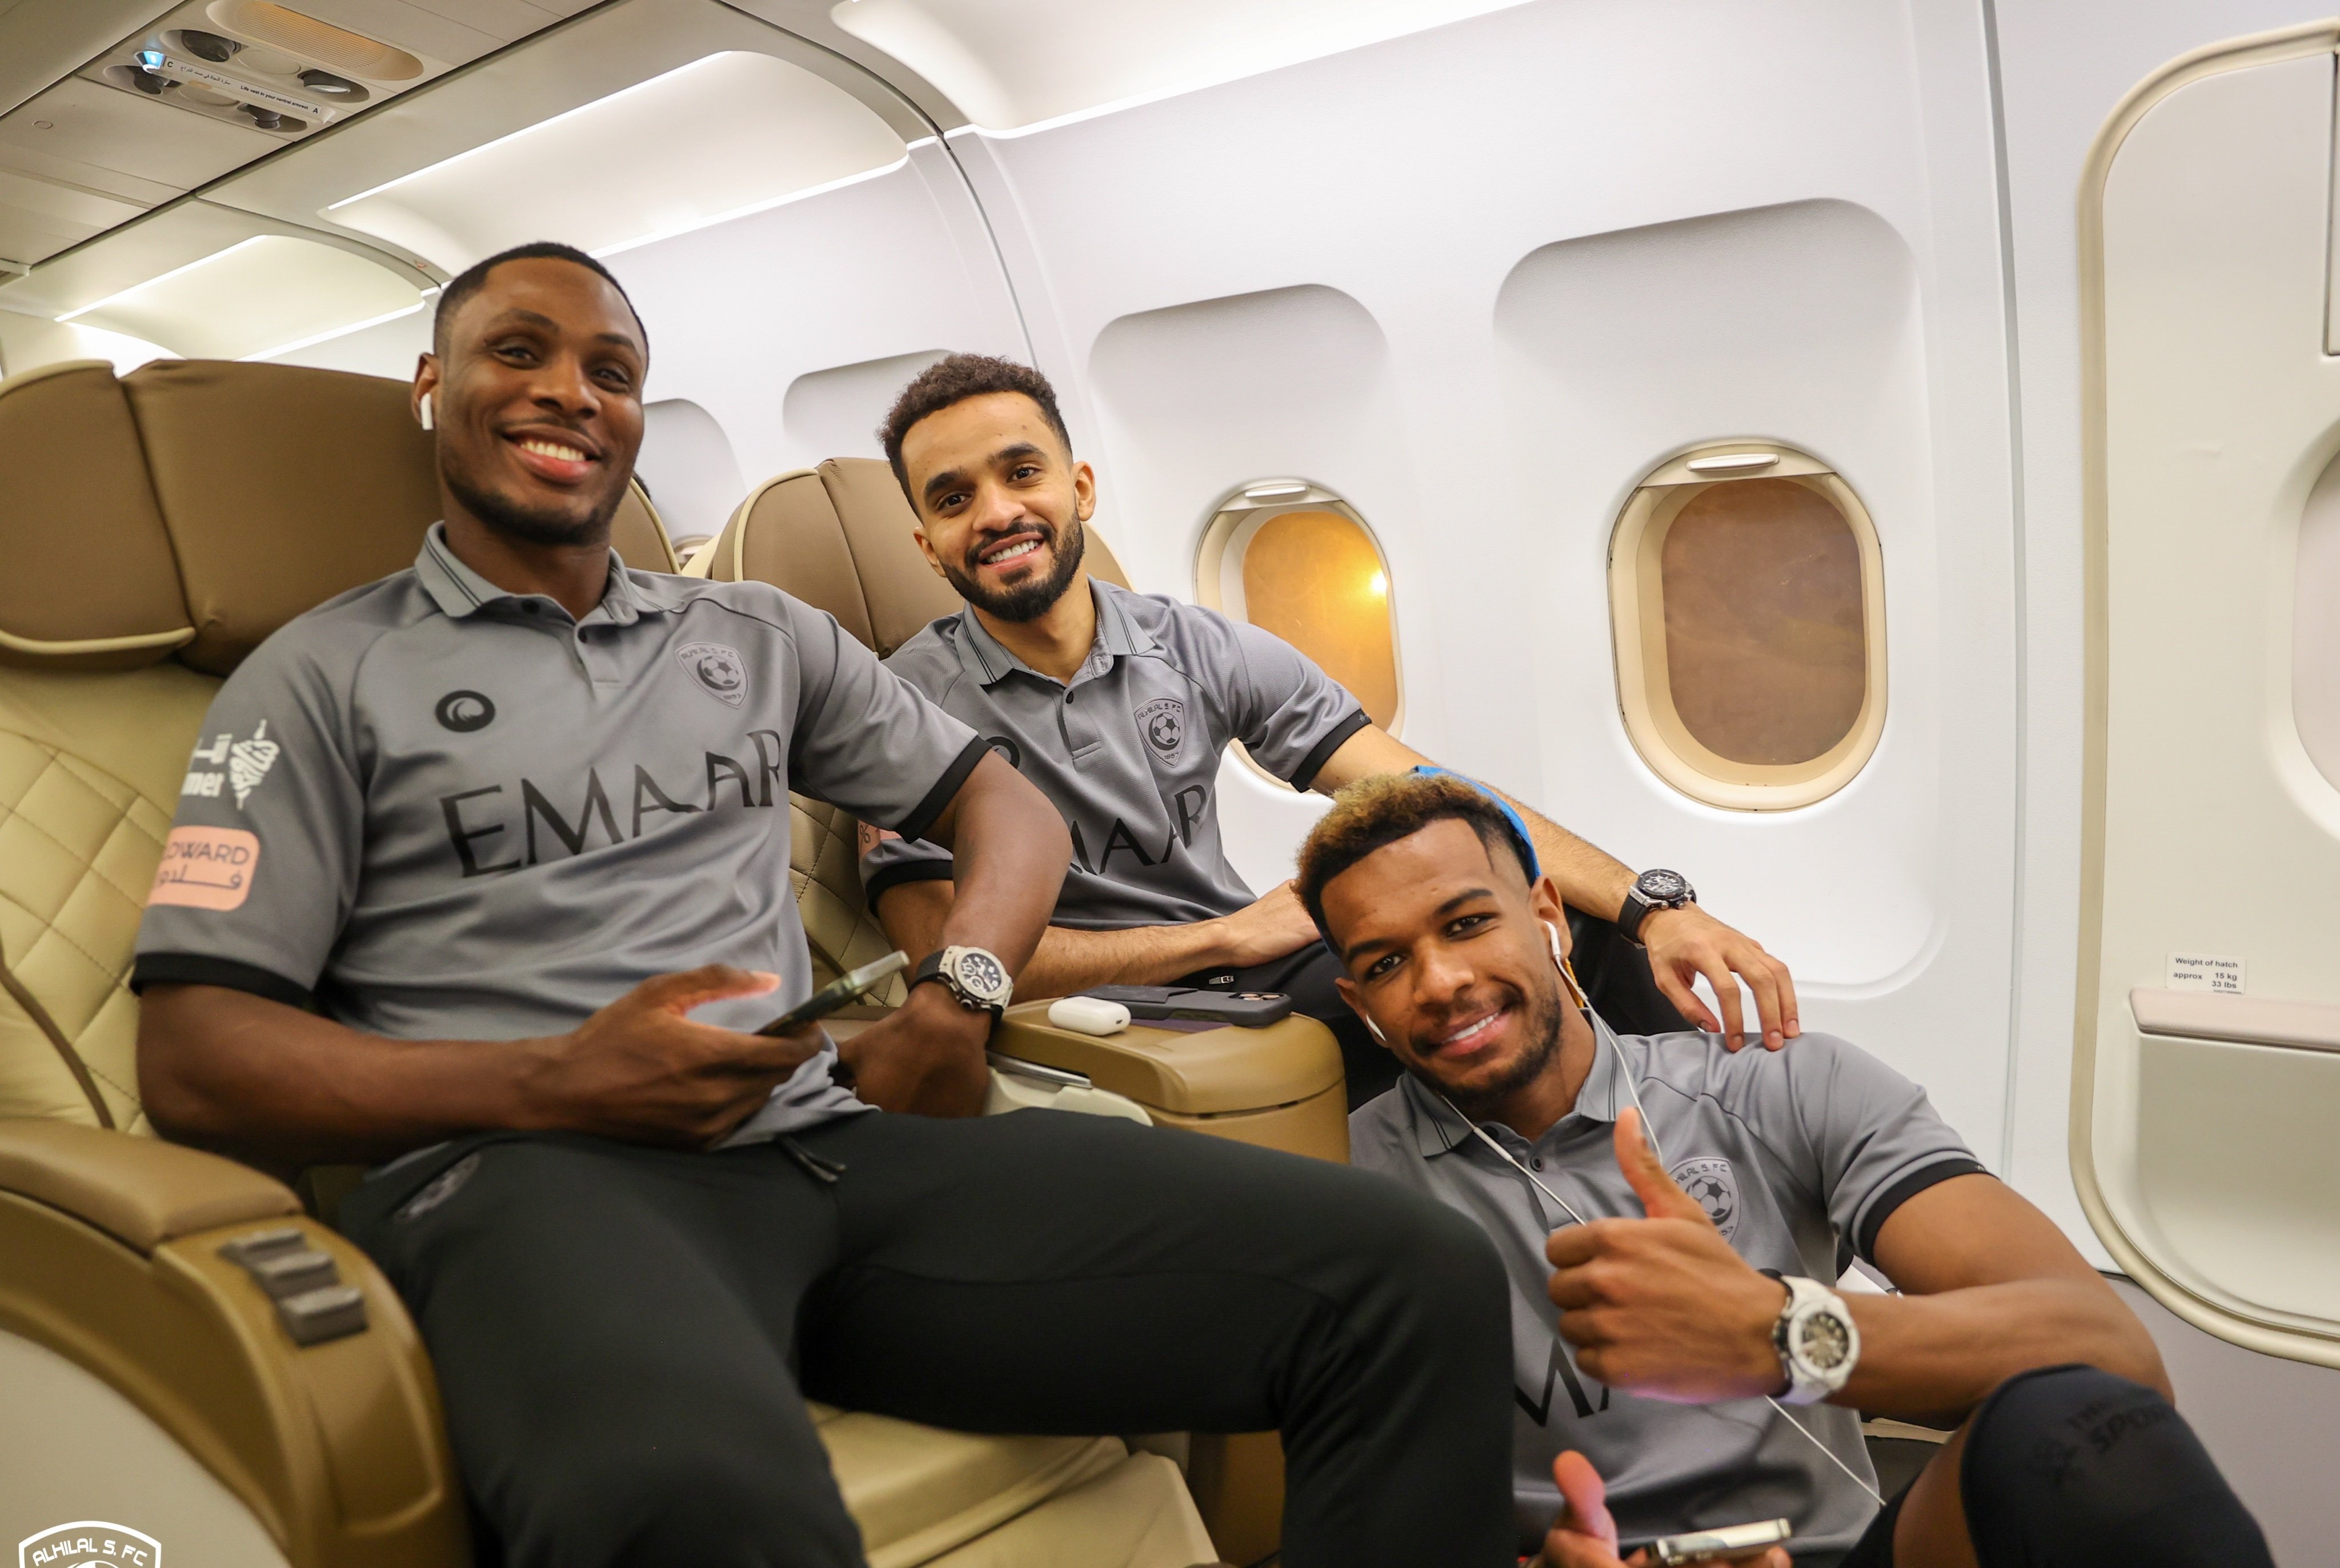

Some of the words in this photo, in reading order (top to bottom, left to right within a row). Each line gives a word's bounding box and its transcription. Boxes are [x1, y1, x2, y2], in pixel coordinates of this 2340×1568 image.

[1164, 752, 1179, 760] 1957
[438, 729, 781, 877] EMAAR
[2175, 957, 2203, 967] Weight
[2173, 972, 2203, 980] approx
